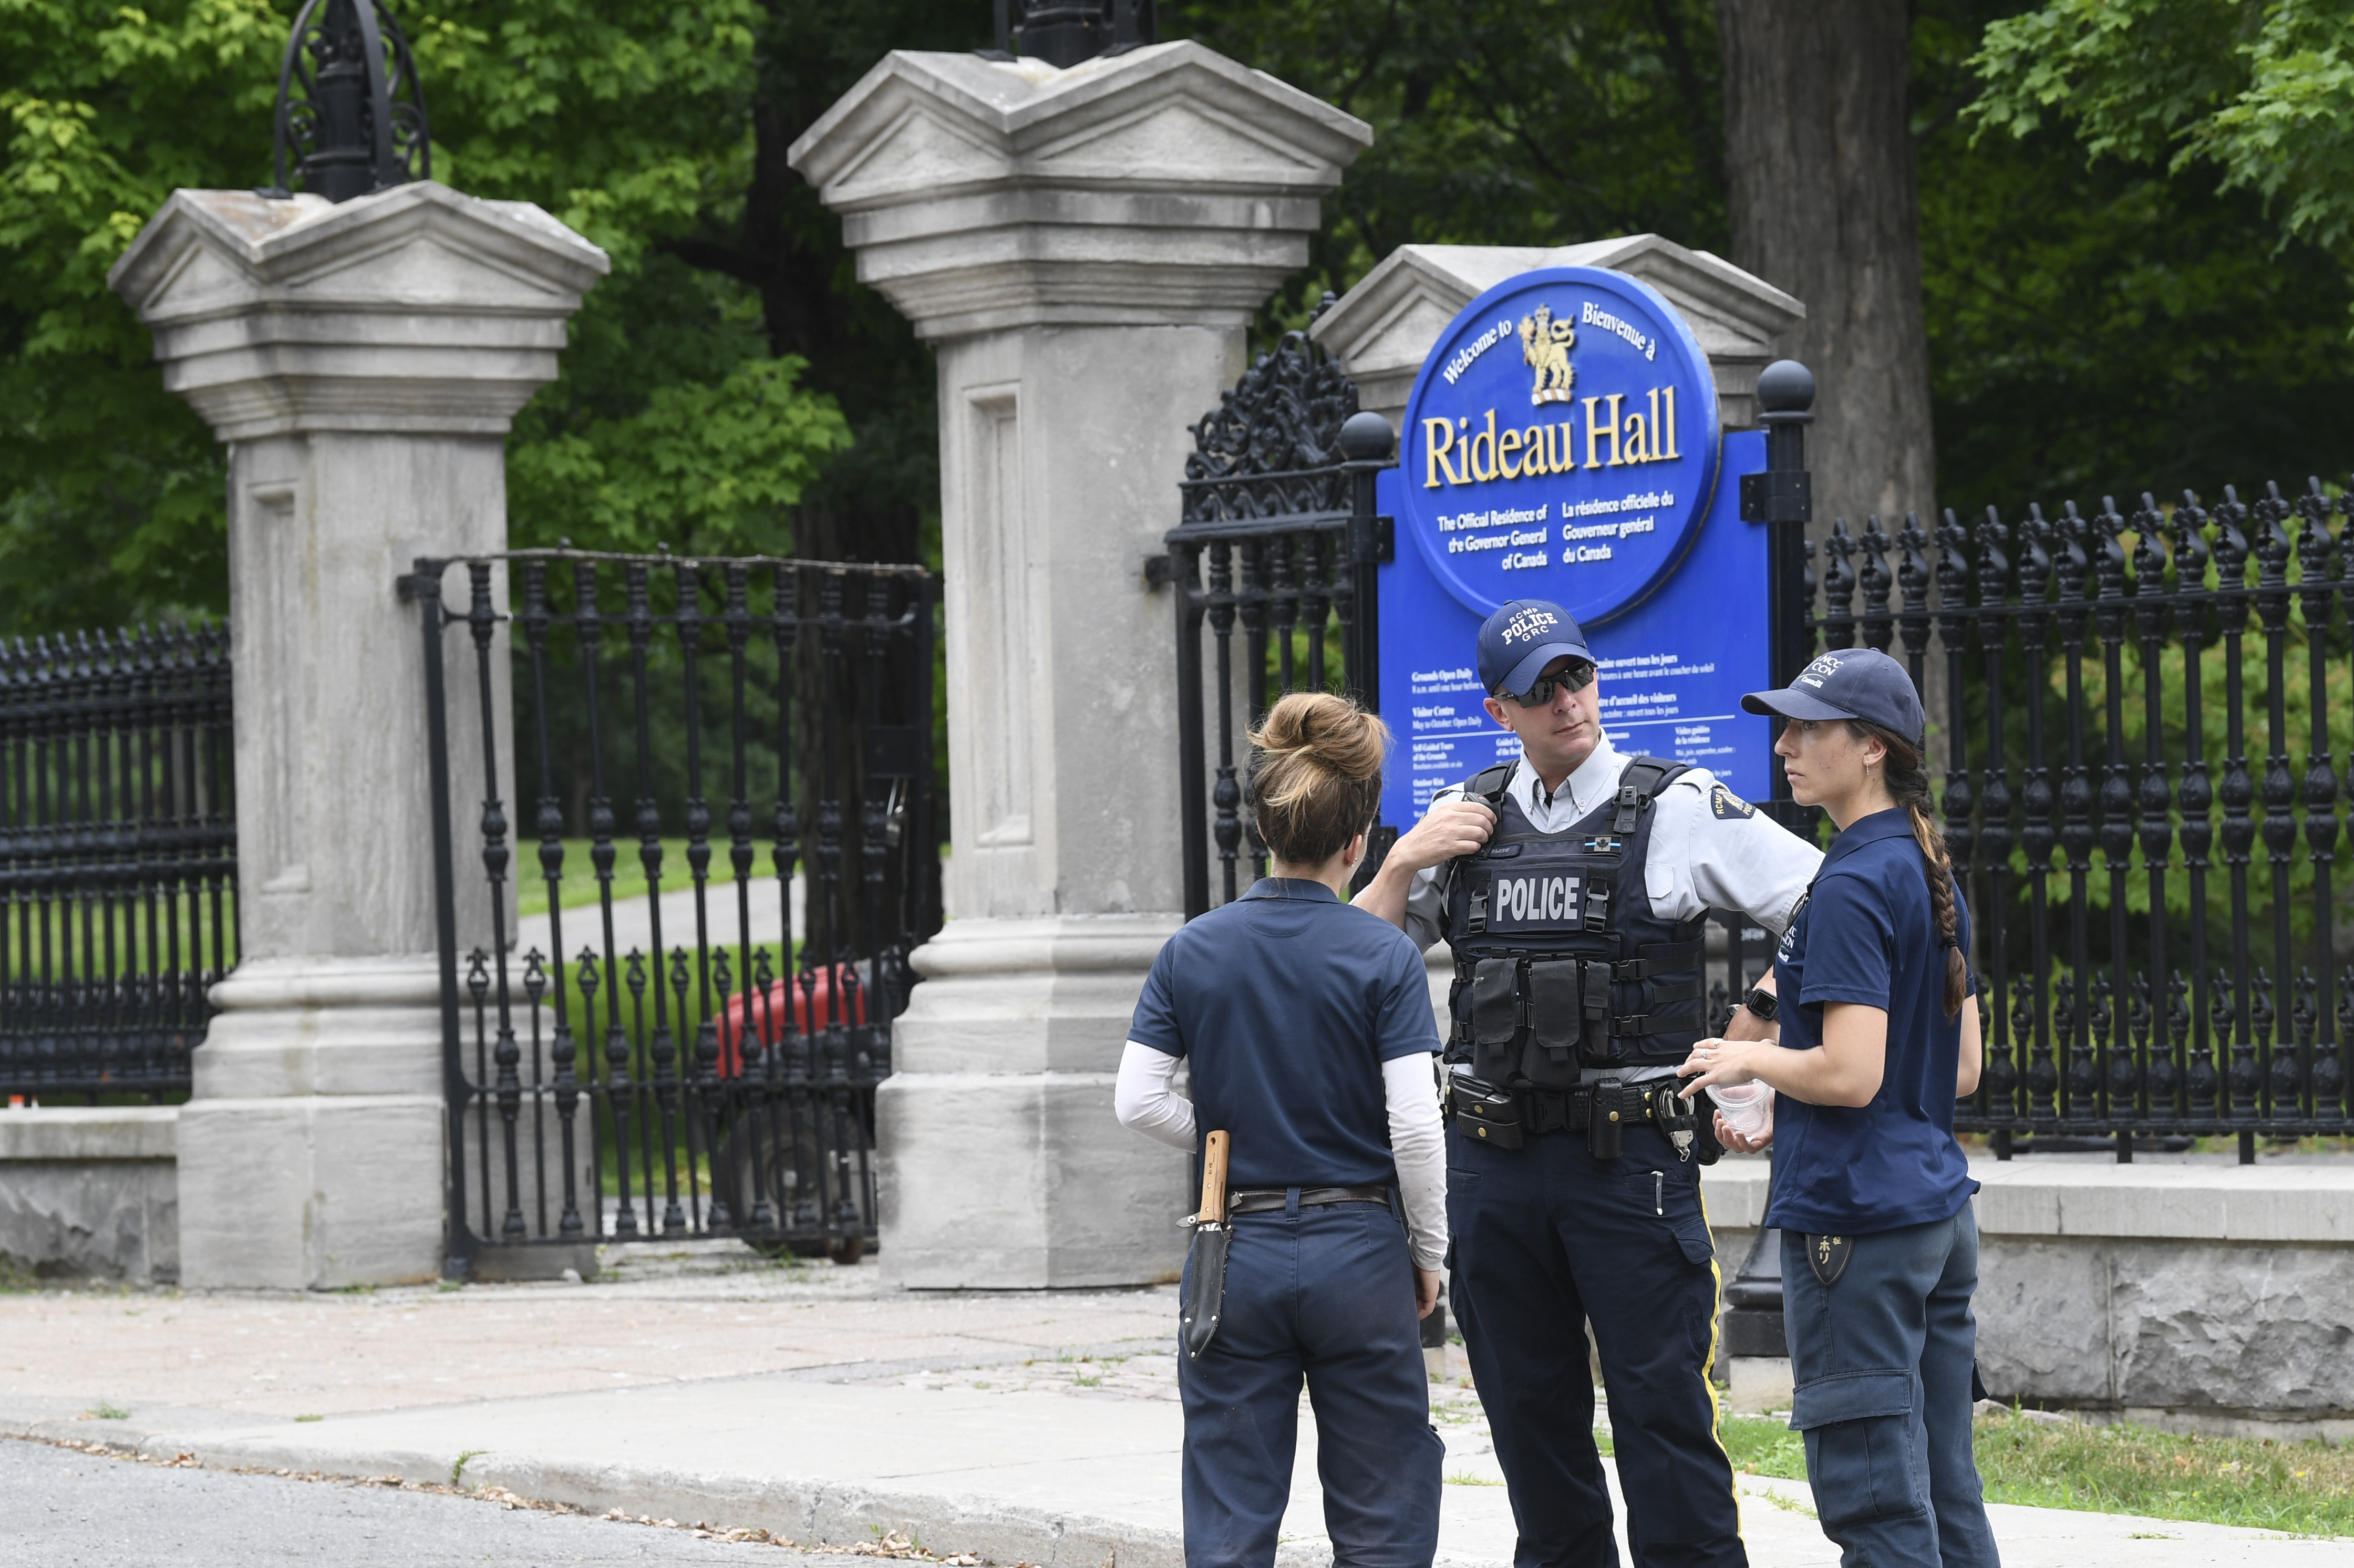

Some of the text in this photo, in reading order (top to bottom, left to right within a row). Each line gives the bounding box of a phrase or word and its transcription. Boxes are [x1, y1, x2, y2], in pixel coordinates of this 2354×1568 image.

[1582, 301, 1655, 361] Bienvenue à
[1443, 319, 1512, 385] Welcome to
[1422, 385, 1679, 488] Rideau Hall
[1562, 490, 1674, 518] La résidence officielle du
[1437, 503, 1547, 532] The Official Residence of
[1449, 527, 1547, 553] the Governor General
[1563, 523, 1618, 540] Gouverneur
[1502, 550, 1547, 570] of Canada
[1563, 543, 1612, 563] du Canada
[1509, 608, 1538, 624] RCMP
[1501, 613, 1558, 645] POLICE
[1522, 625, 1549, 642] GRC
[1615, 657, 1636, 667] ouvert
[1637, 656, 1650, 666] tous
[1650, 654, 1660, 665] les
[1659, 653, 1678, 666] jours
[1812, 663, 1836, 676] CCN
[1819, 655, 1844, 668] NCC
[1439, 670, 1456, 683] Open
[1456, 668, 1473, 680] Daily
[1638, 693, 1649, 705] des
[1649, 692, 1677, 704] visiteurs
[1715, 794, 1725, 814] RCMP
[1496, 877, 1580, 922] POLICE
[1819, 1235, 1831, 1264] ホリ
